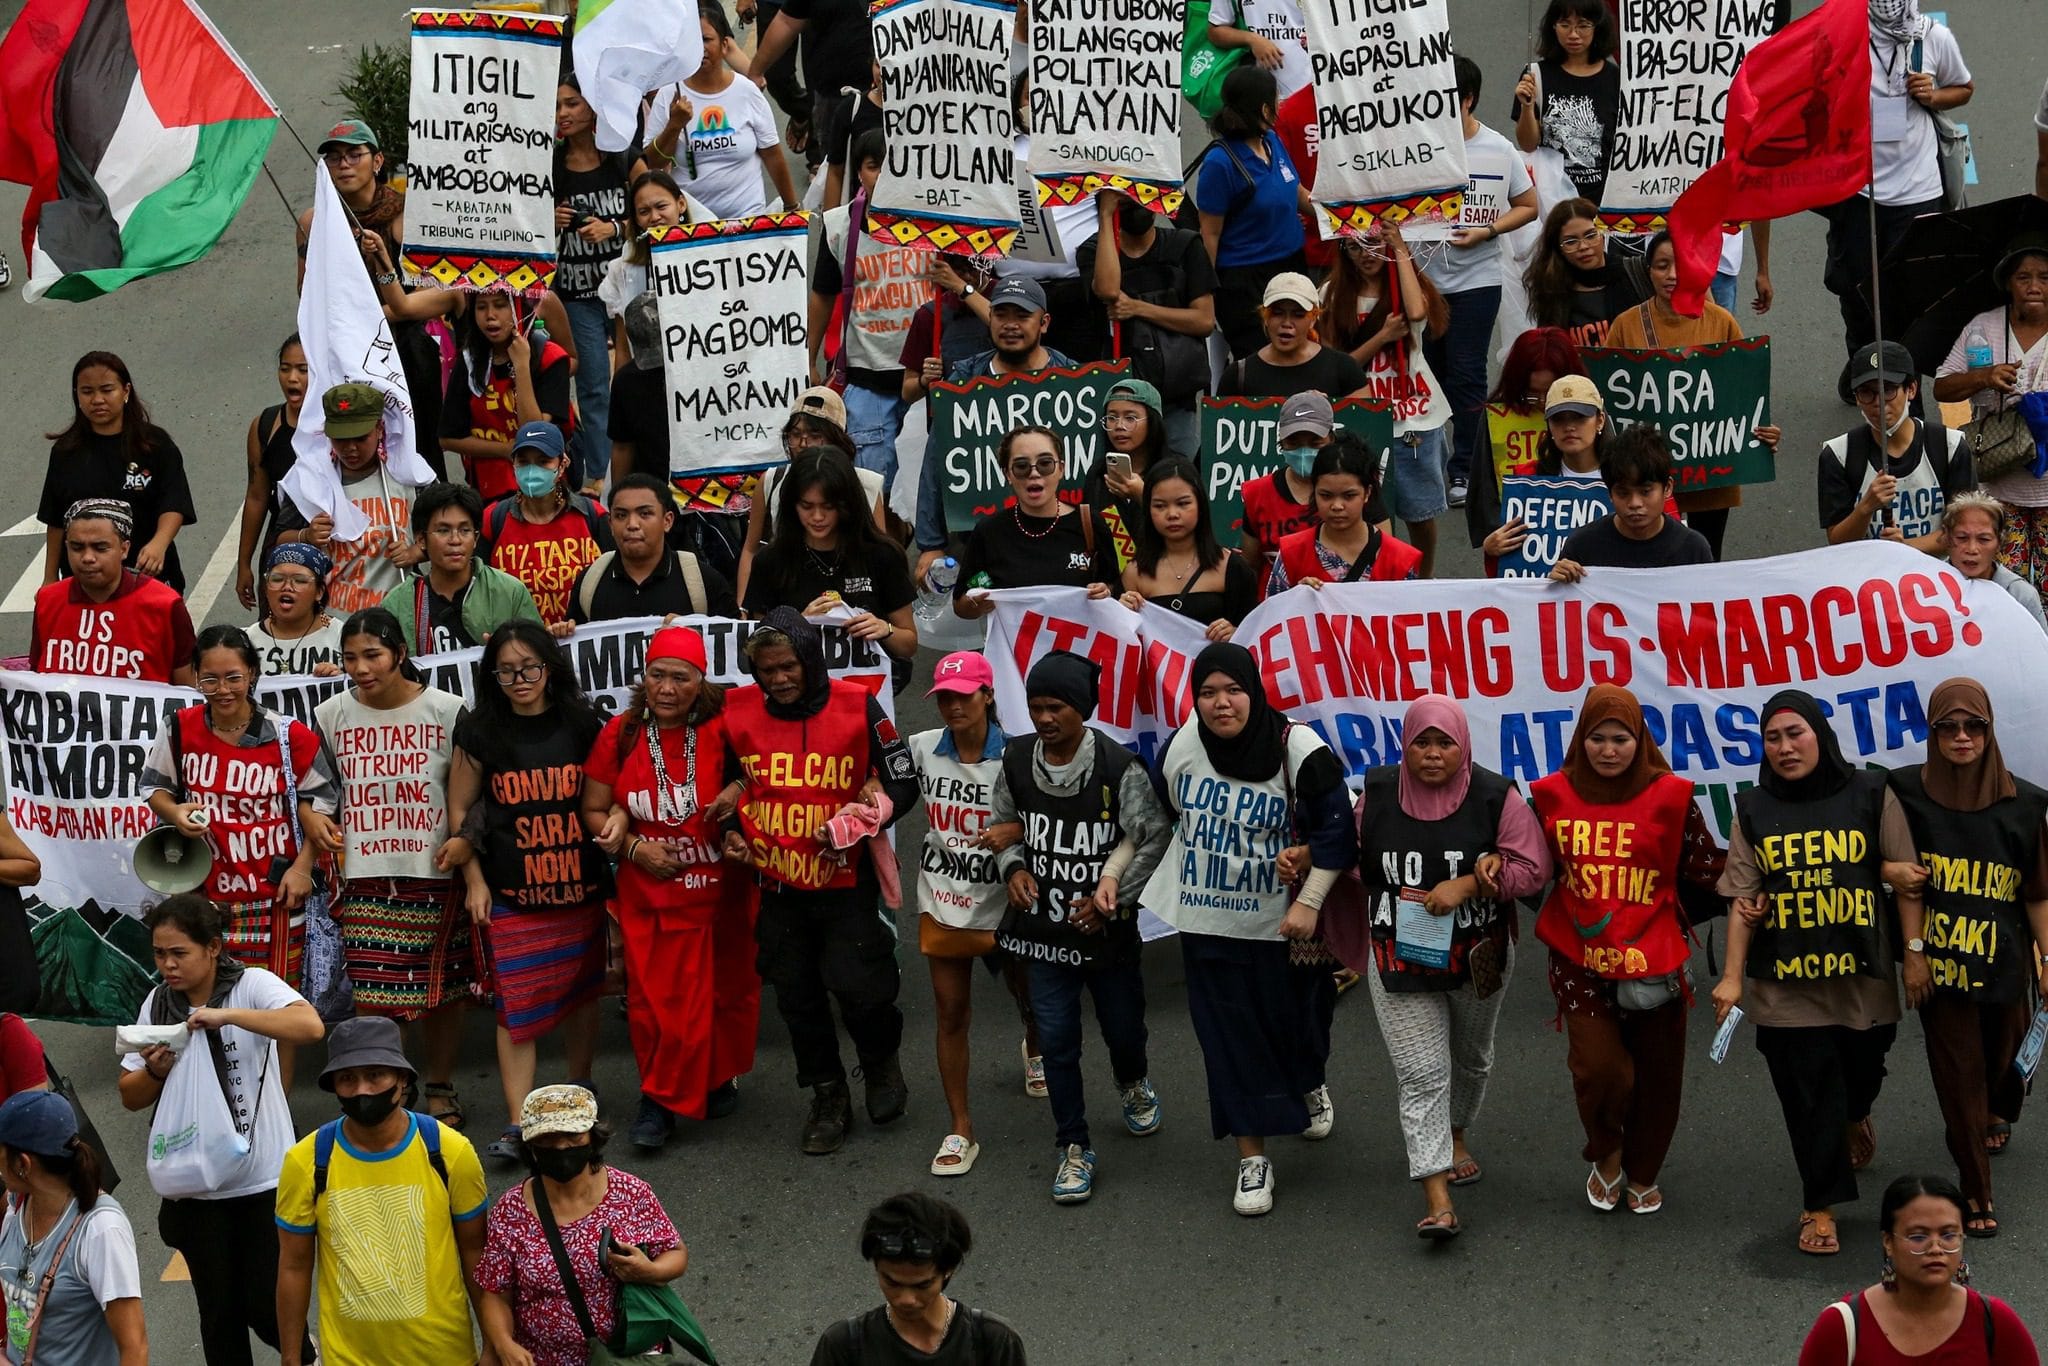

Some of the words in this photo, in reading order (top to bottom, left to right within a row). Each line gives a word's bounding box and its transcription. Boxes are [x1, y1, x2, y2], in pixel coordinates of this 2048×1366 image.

[874, 8, 1010, 61] DAMBUHALA,
[1268, 13, 1287, 26] Fly
[1360, 22, 1395, 40] ang
[1033, 25, 1183, 55] BILANGGONG
[433, 53, 535, 99] ITIGIL
[1033, 55, 1181, 89] POLITIKAL
[1372, 73, 1395, 93] at
[464, 102, 498, 122] ang
[1319, 87, 1459, 140] PAGDUKOT
[464, 144, 492, 164] at
[888, 143, 1015, 185] UTULAN!
[406, 163, 554, 198] PAMBOBOMBA
[420, 225, 473, 239] TRIBUNG
[458, 215, 480, 225] para
[485, 215, 497, 223] sa
[654, 249, 805, 297] HUSTISYA
[720, 300, 749, 316] sa
[665, 312, 809, 362] PAGBOMB
[723, 361, 750, 378] sa
[1608, 369, 1715, 414] SARA
[953, 386, 1097, 439] MARCOS
[1506, 497, 1608, 531] DEFEND
[496, 543, 534, 571] 19%
[1522, 533, 1568, 566] OU
[79, 609, 114, 641] US
[45, 639, 144, 679] TROOPS
[1, 688, 206, 744] KABATA
[335, 726, 376, 758] ZERO
[380, 724, 447, 752] TARIFF
[1500, 709, 1574, 783] AT
[42, 743, 156, 799] MOR
[341, 758, 357, 780] NI
[359, 752, 429, 777] TRUMP.
[343, 782, 389, 809] LUGI
[396, 780, 430, 805] ANG
[492, 763, 584, 805] CONVICT
[344, 808, 443, 834] PILIPINAS!
[515, 811, 584, 849] SARA
[228, 822, 289, 863] NCIP
[1556, 819, 1635, 858] FREE
[524, 850, 581, 885] NOW
[1033, 855, 1047, 878] IS
[1052, 859, 1103, 883] NOT
[1180, 850, 1197, 887] A
[1444, 851, 1489, 880] T
[1786, 868, 1833, 889] THE
[1180, 891, 1260, 912] PANAGHIUSA
[1775, 953, 1856, 980] MCPA
